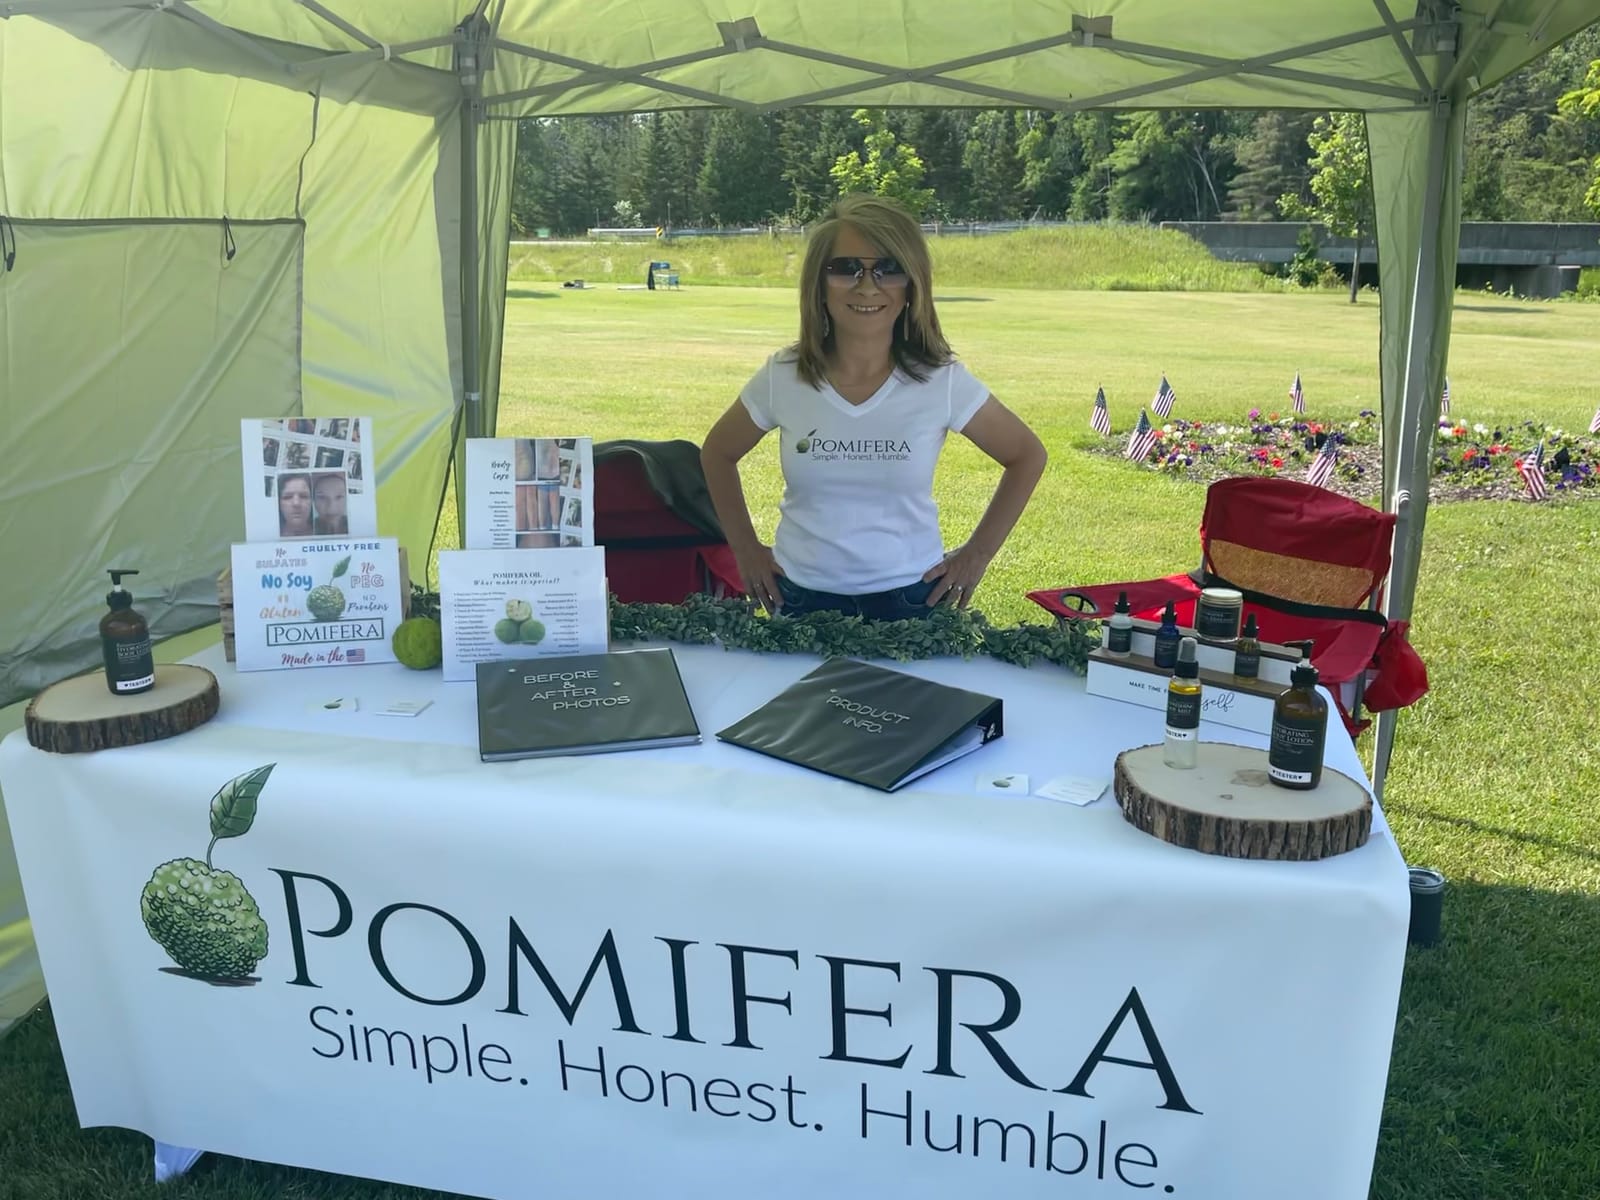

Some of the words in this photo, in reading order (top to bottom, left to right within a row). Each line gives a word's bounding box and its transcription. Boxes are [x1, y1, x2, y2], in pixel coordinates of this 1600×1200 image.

[811, 438, 911, 452] POMIFERA
[302, 544, 350, 553] CRUELTY
[353, 543, 381, 551] FREE
[256, 558, 308, 569] SULFATES
[361, 562, 375, 574] No
[262, 574, 282, 589] No
[287, 572, 313, 591] Soy
[351, 574, 384, 589] PEG
[273, 623, 379, 643] POMIFERA
[281, 653, 314, 666] Made
[316, 652, 325, 662] in
[327, 646, 344, 663] the
[524, 670, 599, 684] BEFORE
[563, 681, 576, 689] &
[1129, 681, 1145, 689] MAKE
[1148, 685, 1161, 693] TIME
[531, 687, 597, 700] AFTER
[553, 695, 631, 710] PHOTOS
[826, 695, 910, 724] PRODUCT
[268, 867, 1204, 1115] POMIFERA
[309, 1005, 529, 1087] Simple.
[558, 1038, 824, 1133] Honest.
[860, 1082, 1175, 1194] Humble.
